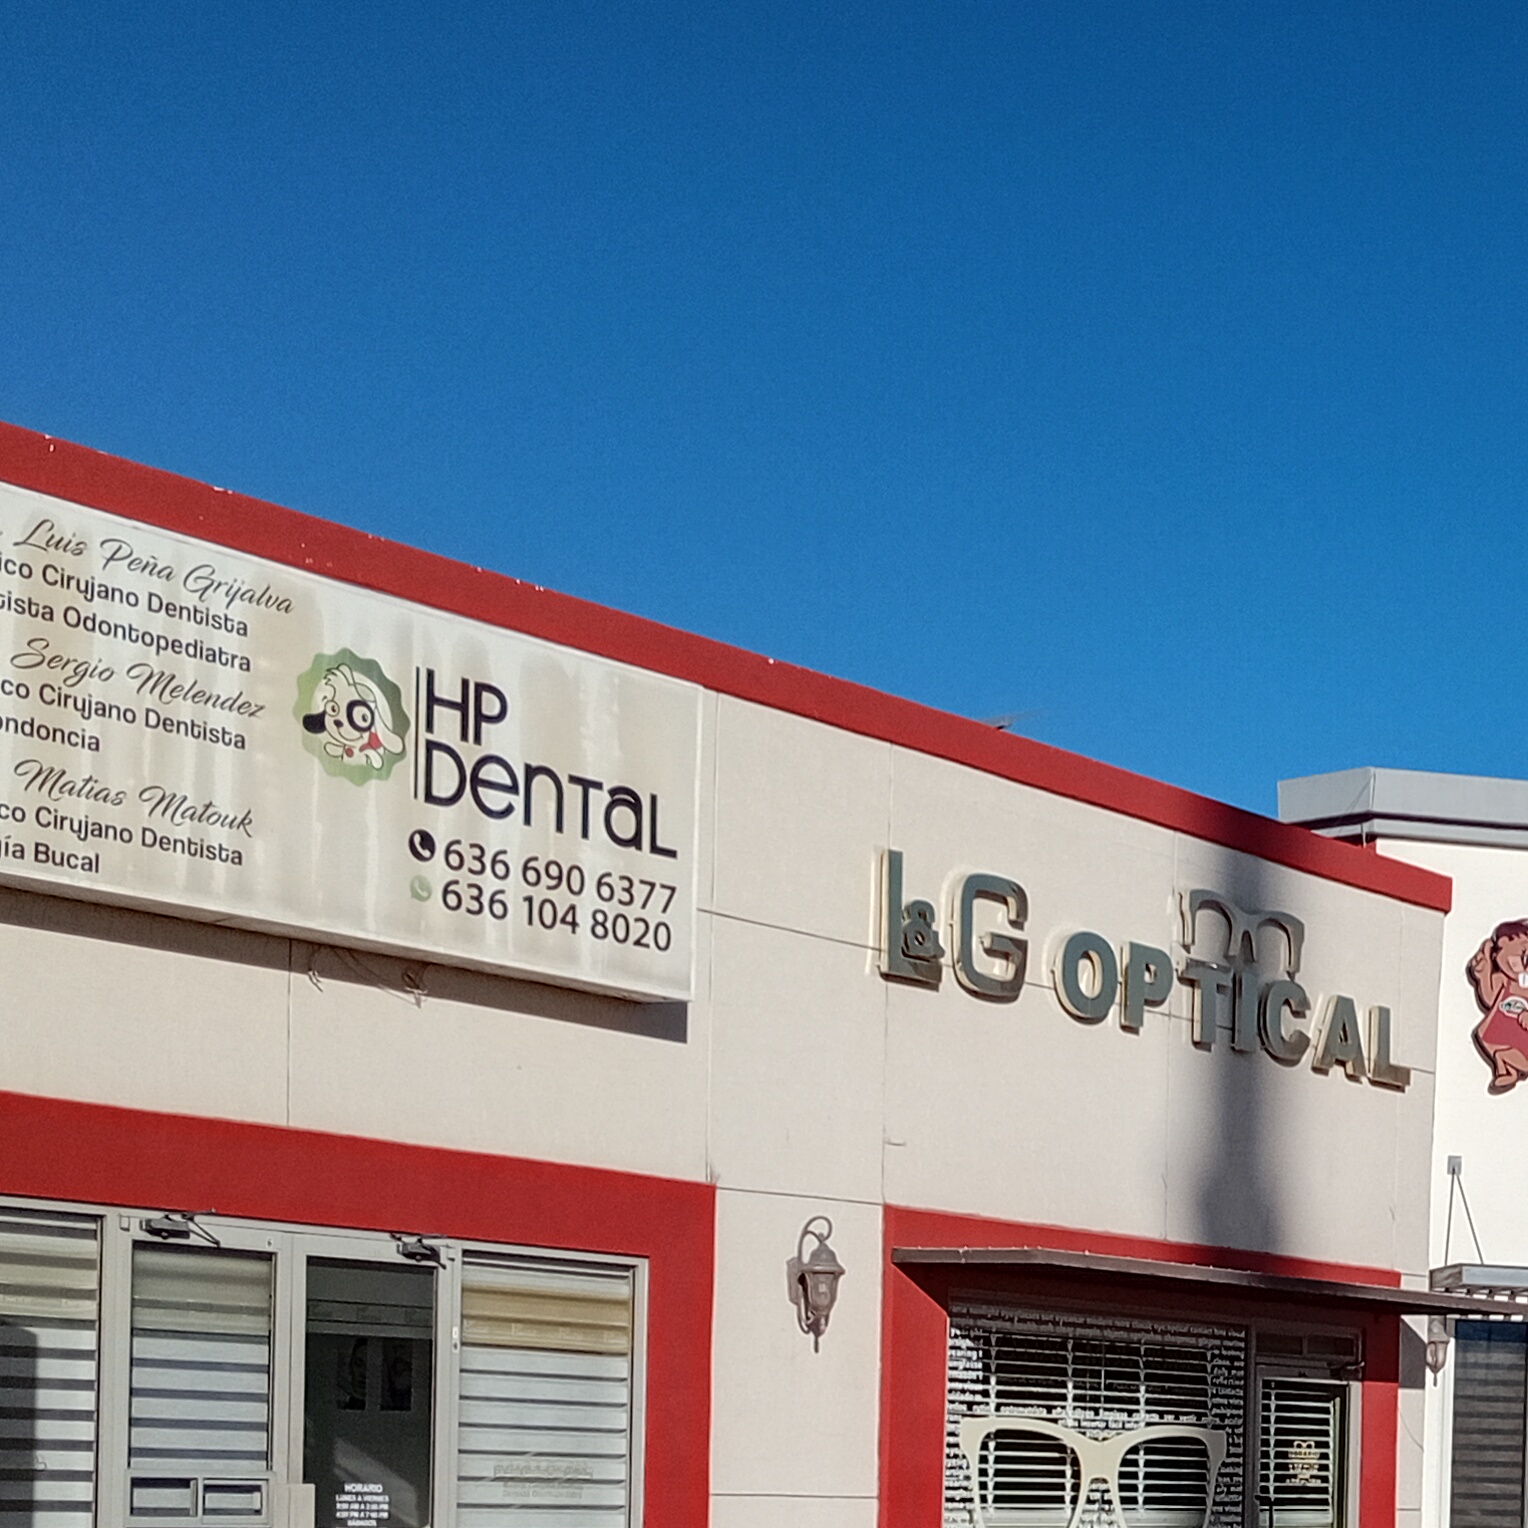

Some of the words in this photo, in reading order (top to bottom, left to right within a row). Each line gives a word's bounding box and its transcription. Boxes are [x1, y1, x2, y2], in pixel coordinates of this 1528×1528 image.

[13, 518, 88, 556] Luis
[100, 538, 174, 582] Peña
[183, 564, 295, 615] Grijalva
[42, 563, 139, 607] Cirujano
[148, 591, 248, 637] Dentista
[63, 605, 251, 672] Odontopediatra
[10, 637, 116, 688] Sergio
[126, 662, 266, 719] Melendez
[425, 668, 508, 746] HP
[0, 713, 100, 752] ndoncia
[39, 683, 136, 724] Cirujano
[144, 707, 246, 750] Dentista
[13, 758, 128, 807] Matias
[138, 785, 254, 838] Matouk
[0, 835, 25, 861] ía
[34, 841, 100, 874] Bucal
[35, 805, 133, 848] Cirujano
[141, 827, 243, 866] Dentista
[444, 839, 510, 881] 636
[522, 856, 585, 896] 690
[596, 872, 677, 914] 6377
[442, 879, 508, 920] 636
[523, 895, 579, 934] 104
[591, 909, 671, 952] 8020
[1054, 930, 1412, 1090] OPTICAL
[344, 1483, 383, 1493] HORARIO
